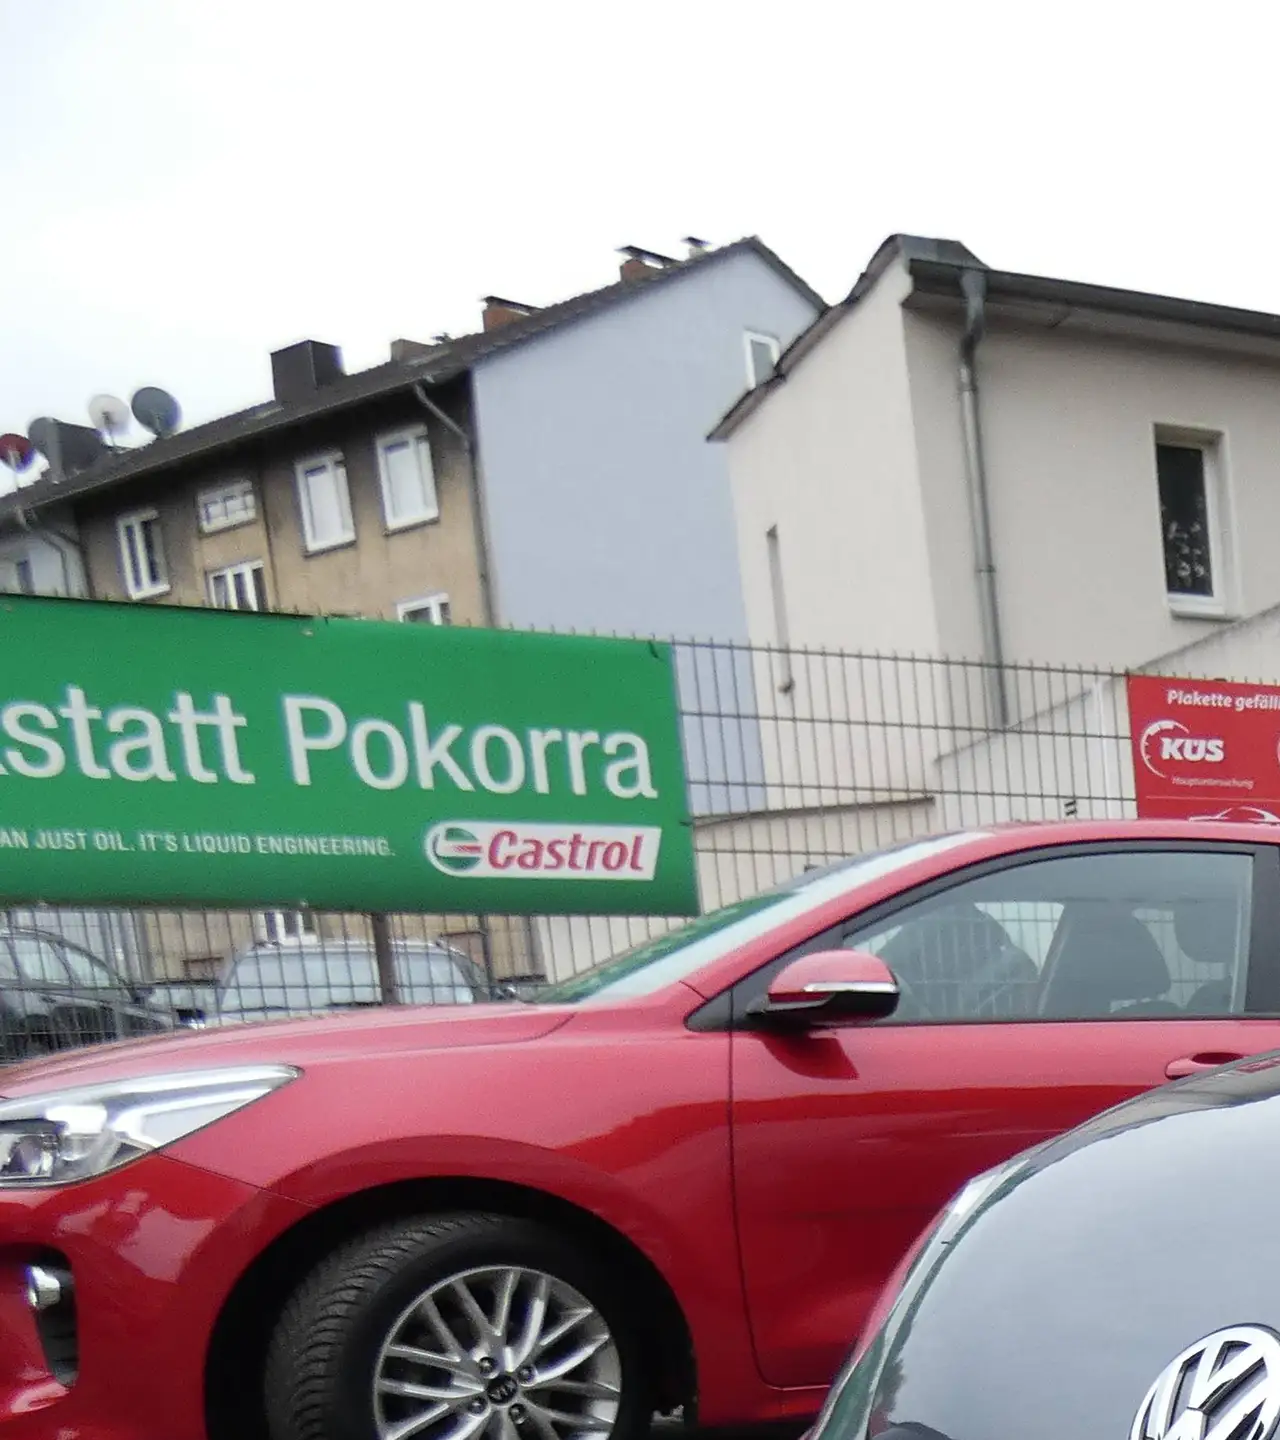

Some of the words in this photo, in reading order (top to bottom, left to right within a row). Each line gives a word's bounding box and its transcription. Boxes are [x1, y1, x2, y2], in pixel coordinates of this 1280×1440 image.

[1167, 690, 1232, 708] Plakette
[0, 684, 255, 784] statt
[284, 696, 659, 799] Pokorra
[35, 830, 87, 850] JUST
[94, 831, 136, 851] OIL.
[140, 832, 178, 852] IT'S
[183, 833, 251, 853] LIQUID
[255, 835, 396, 856] ENGINEERING.
[488, 830, 644, 871] Castrol
